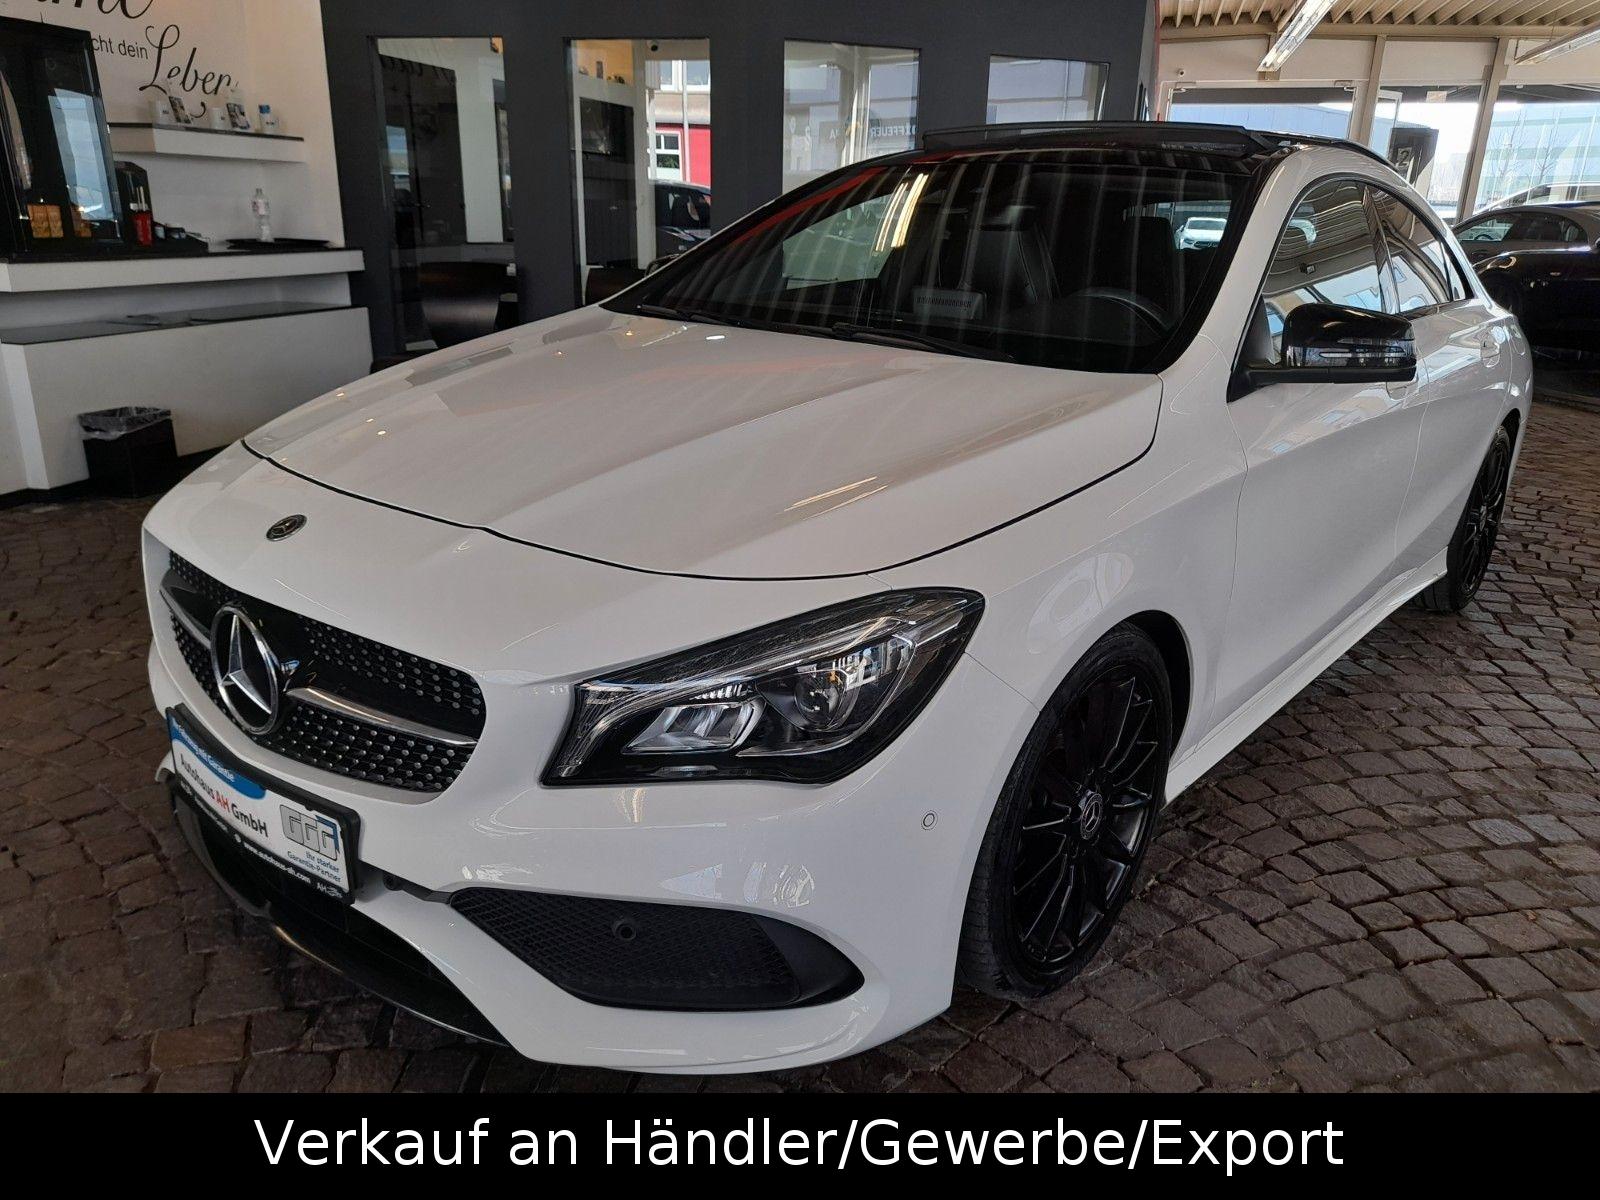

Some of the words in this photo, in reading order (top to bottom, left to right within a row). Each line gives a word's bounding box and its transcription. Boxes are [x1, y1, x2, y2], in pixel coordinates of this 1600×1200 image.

[92, 35, 114, 54] cht
[118, 40, 148, 60] dein
[180, 754, 215, 801] Autohaus
[214, 790, 230, 811] AH
[231, 804, 269, 838] GmbH
